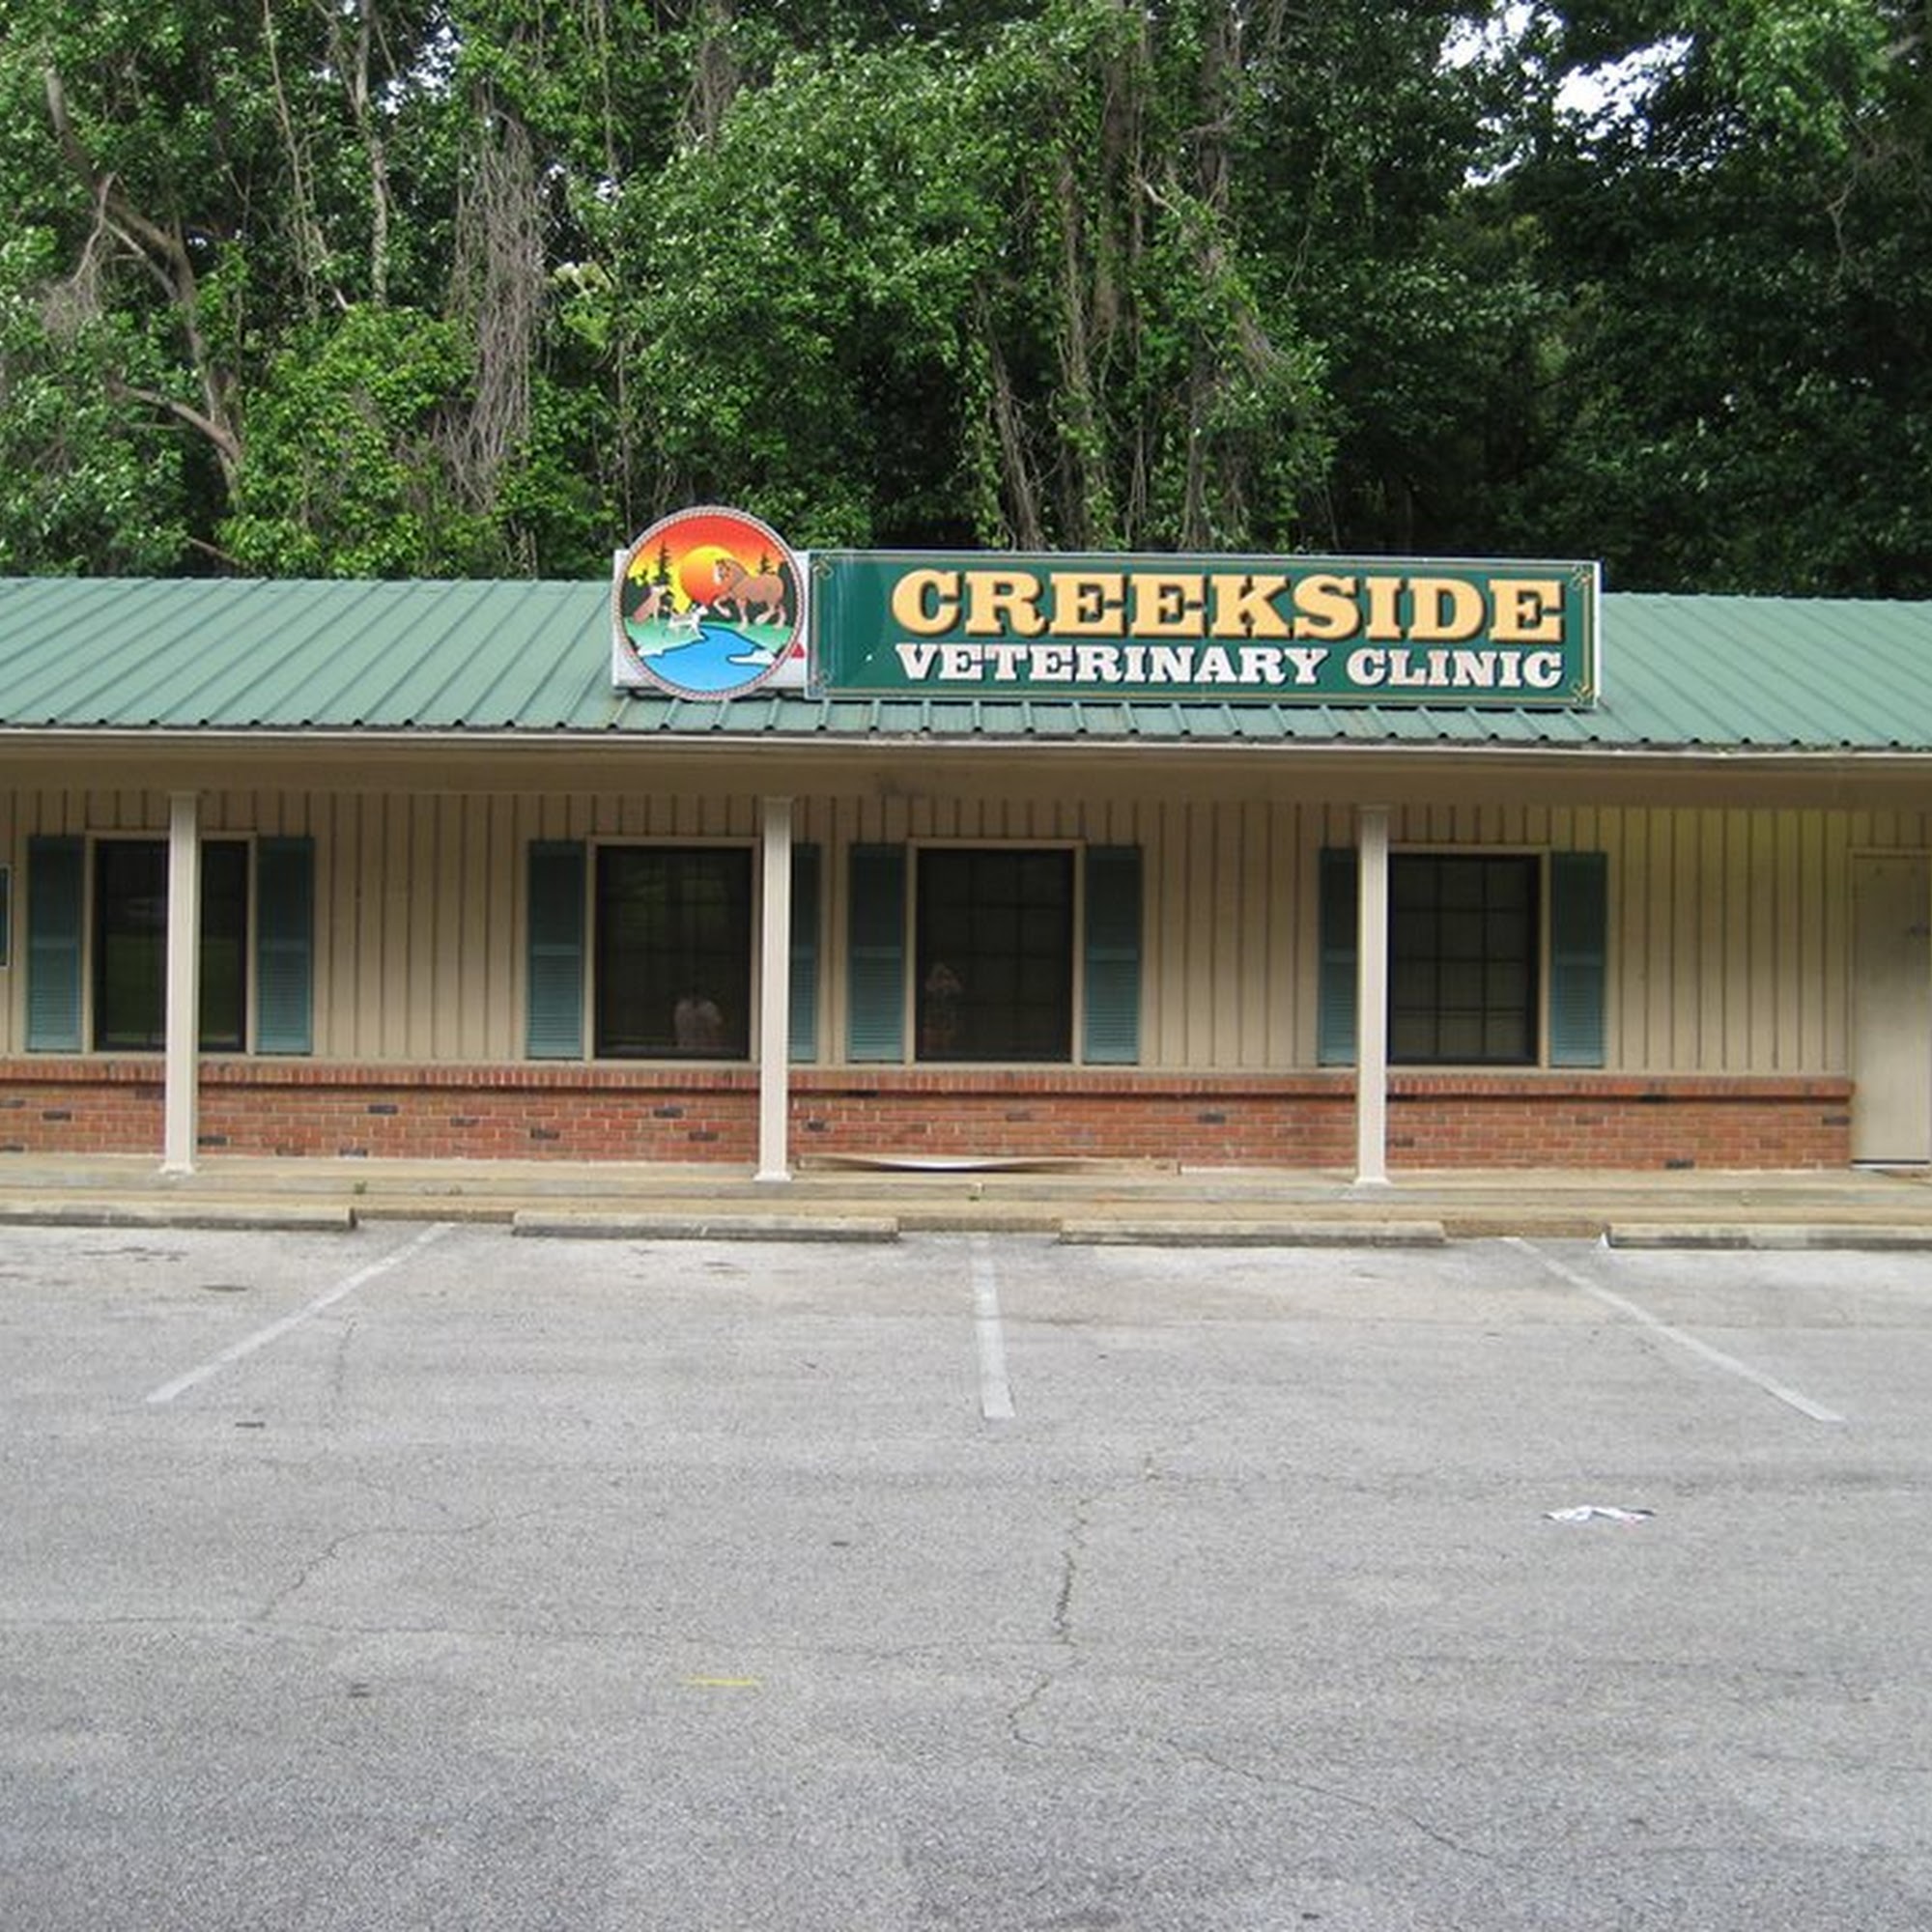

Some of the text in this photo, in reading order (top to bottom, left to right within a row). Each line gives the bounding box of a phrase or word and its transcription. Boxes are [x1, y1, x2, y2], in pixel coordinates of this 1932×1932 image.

[892, 569, 1564, 643] CREEKSIDE
[896, 643, 1563, 689] VETERINARY CLINIC
